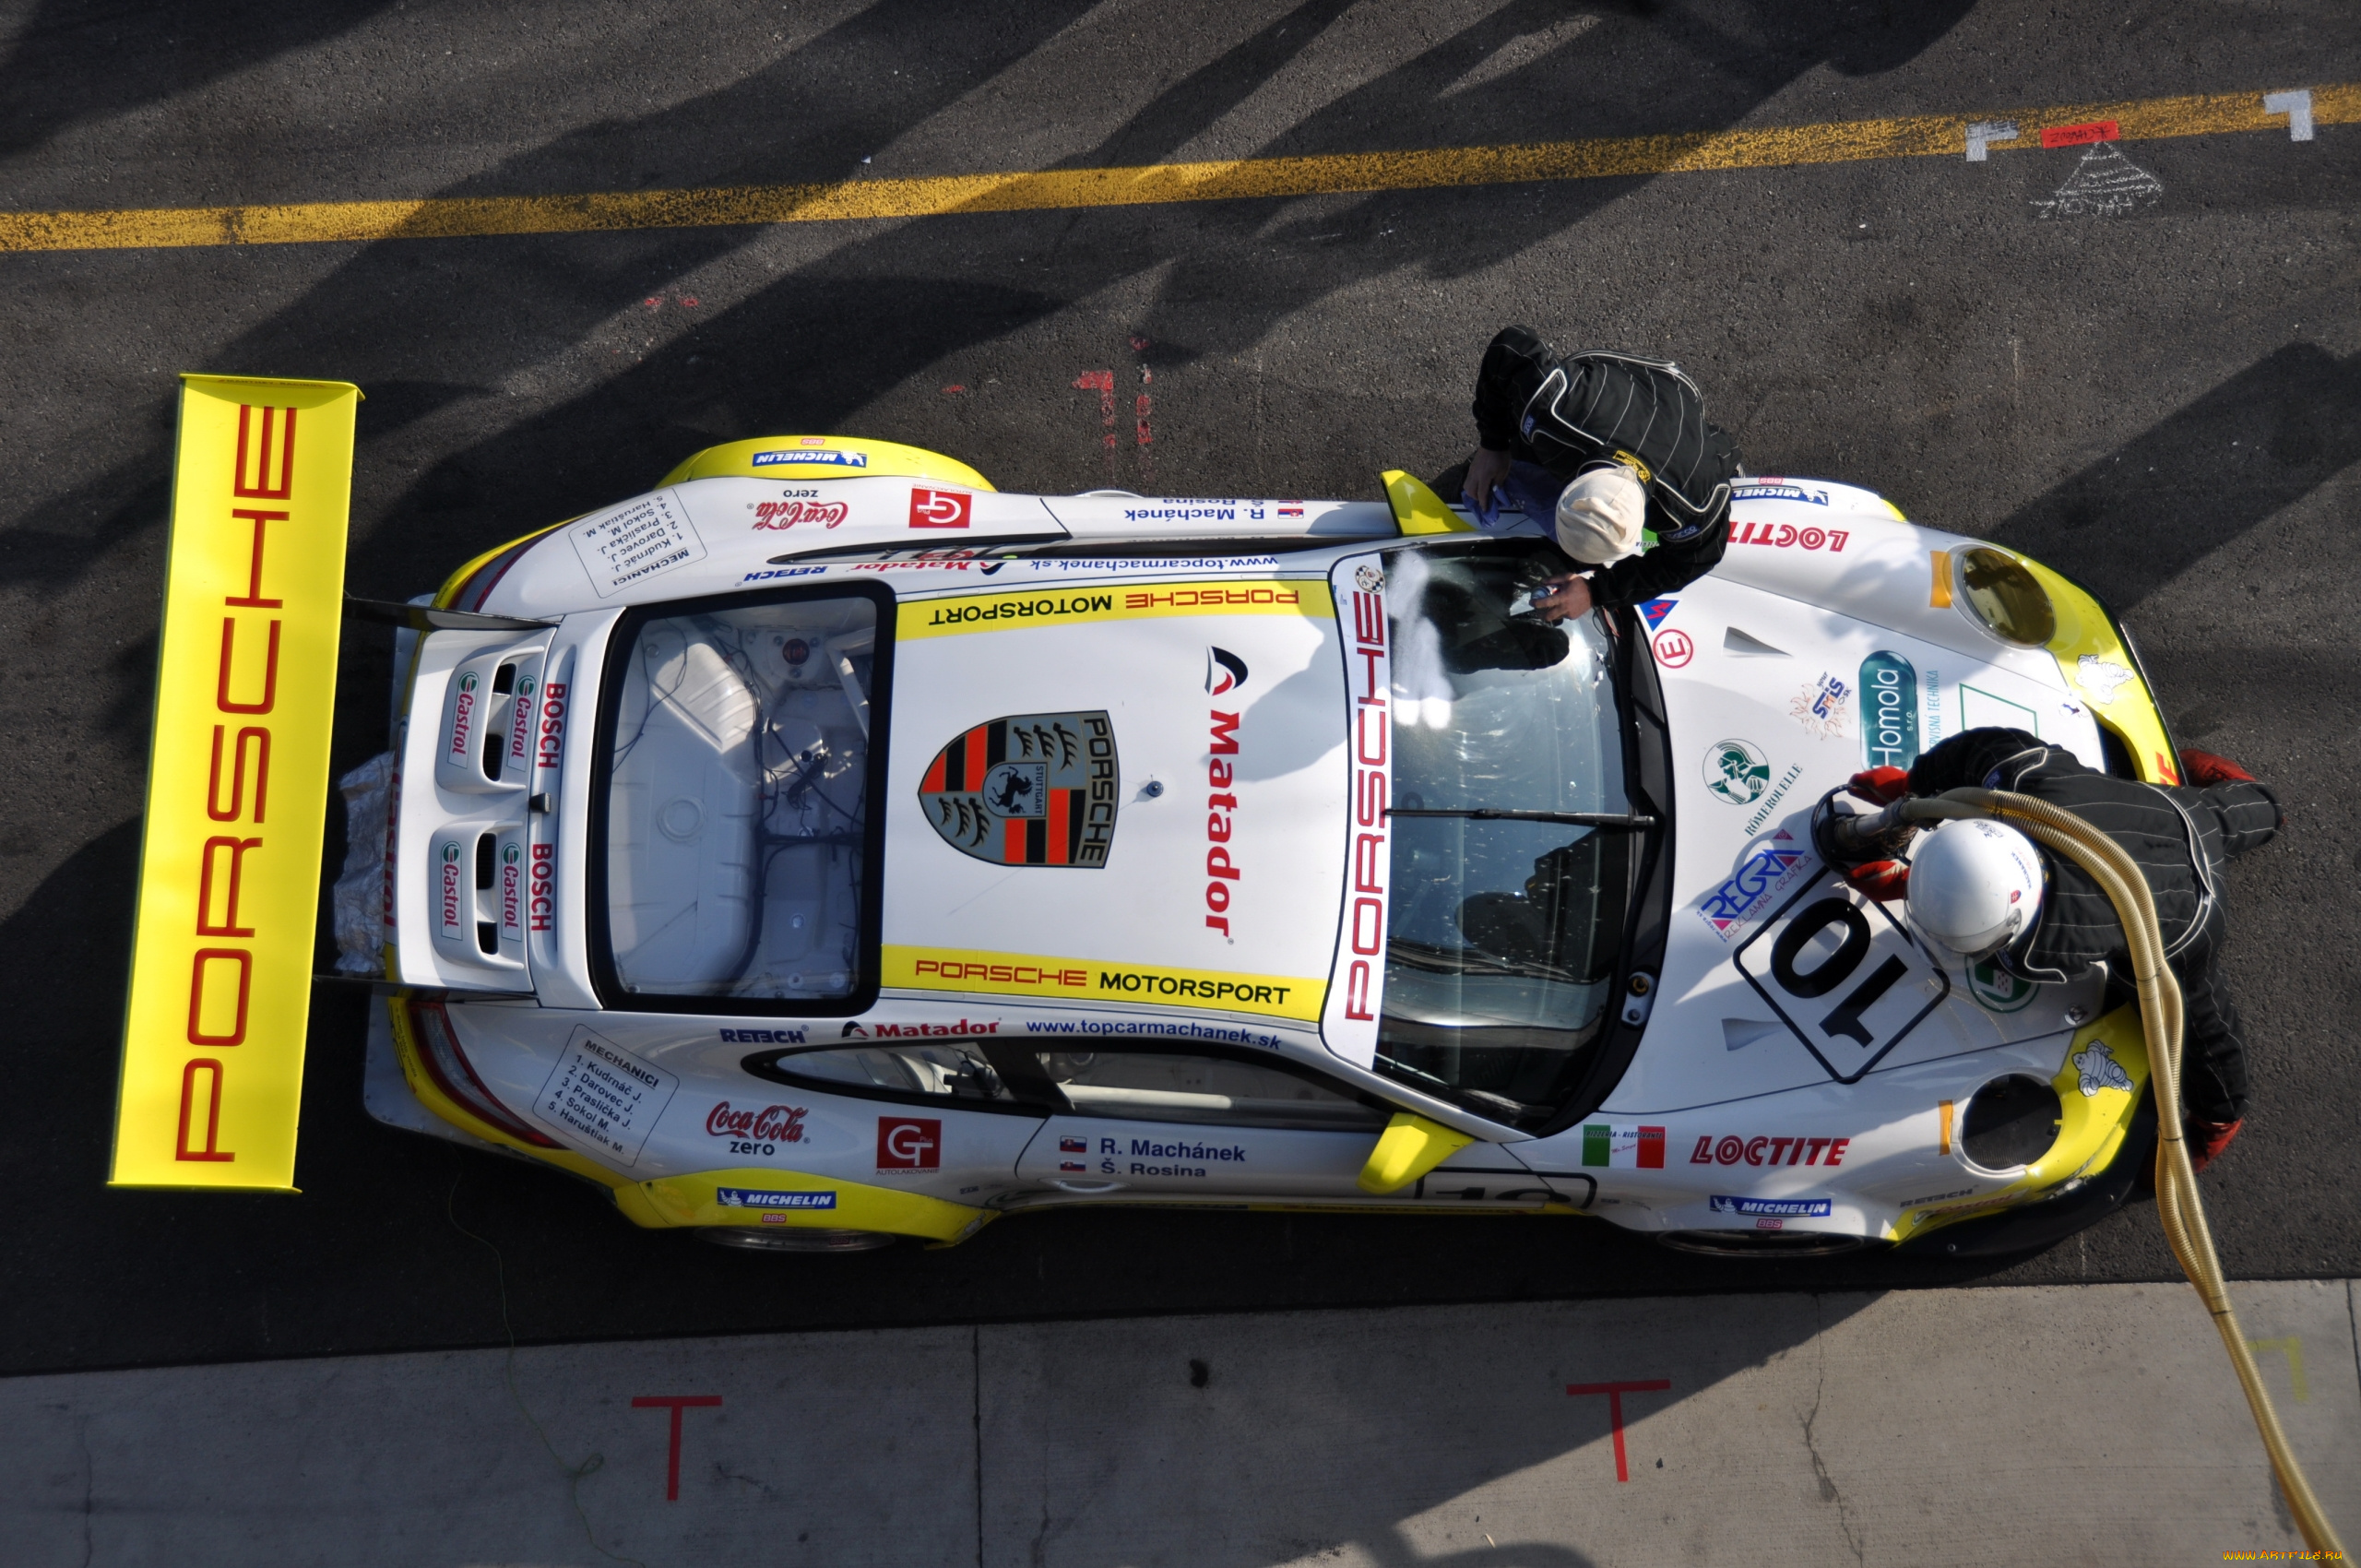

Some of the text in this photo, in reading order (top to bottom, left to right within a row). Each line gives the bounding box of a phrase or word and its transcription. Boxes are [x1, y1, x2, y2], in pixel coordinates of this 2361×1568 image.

[756, 452, 838, 464] MICHELIN
[783, 489, 819, 498] zero
[1732, 488, 1801, 498] MICHEL
[1759, 477, 1784, 485] BBS
[583, 528, 597, 539] M.
[597, 510, 673, 555] 3. Praslička J.
[599, 501, 651, 531] Haruštiak
[607, 502, 668, 537] 4. Sokol M.
[752, 501, 849, 530] Coca-Cola
[1124, 508, 1264, 523] R. Machánek
[607, 520, 679, 563] 2. Darovec J.
[611, 532, 684, 573] 1. Kudrnáč J.
[1726, 521, 1850, 552] LOCTIT
[612, 548, 691, 586] MECHANICI
[850, 561, 973, 573] Matador
[1030, 554, 1279, 572] www.topcarmachanek.sk
[928, 589, 1300, 627] PORSCHE MOTORSPORT
[1926, 670, 1940, 711] TECHNIKA
[453, 692, 474, 755] Castrol
[511, 695, 532, 758] Castrol
[539, 683, 566, 768] BOSCH
[1870, 668, 1903, 769] Homola
[175, 403, 297, 1162] PORSCHE
[1034, 766, 1043, 815] STUTTGART
[1080, 718, 1113, 861] PORSCHE
[1205, 709, 1240, 938] Matador
[1345, 590, 1386, 1022] PORSCHE
[441, 863, 459, 928] Castrol
[502, 864, 519, 929] Castrol
[531, 843, 553, 932] BOSCH
[1724, 854, 1812, 940] REKLAMNÁ GRAFIKA
[915, 959, 1291, 1005] PORSCHE MOTORSPORT
[1770, 897, 1909, 1049] 10
[875, 1018, 1001, 1038] Matador
[1026, 1019, 1283, 1051] www.topcarmachanek.sk
[576, 1054, 642, 1104] 1. Kudrnáč J.
[585, 1039, 659, 1089] MECHANICI
[562, 1076, 631, 1131] 3. Praslička J.
[568, 1065, 634, 1115] 2. Darovec J.
[548, 1101, 625, 1155] 5. Haruštiak M.
[554, 1089, 610, 1133] 4. Sokol M.
[706, 1100, 810, 1143] Coca-Cola
[730, 1140, 776, 1156] zero
[1100, 1137, 1246, 1162] R. Machánek
[1622, 1131, 1664, 1139] RISTORANTE
[1689, 1135, 1850, 1166] LOCTITE
[876, 1167, 940, 1176] AUTOLAKOVANIE
[1100, 1158, 1206, 1178] Š. Rosina
[746, 1194, 833, 1206] MICHELIN
[763, 1215, 787, 1223] BBS
[1740, 1201, 1829, 1215] MICHELIN
[1757, 1218, 1783, 1229] BBS
